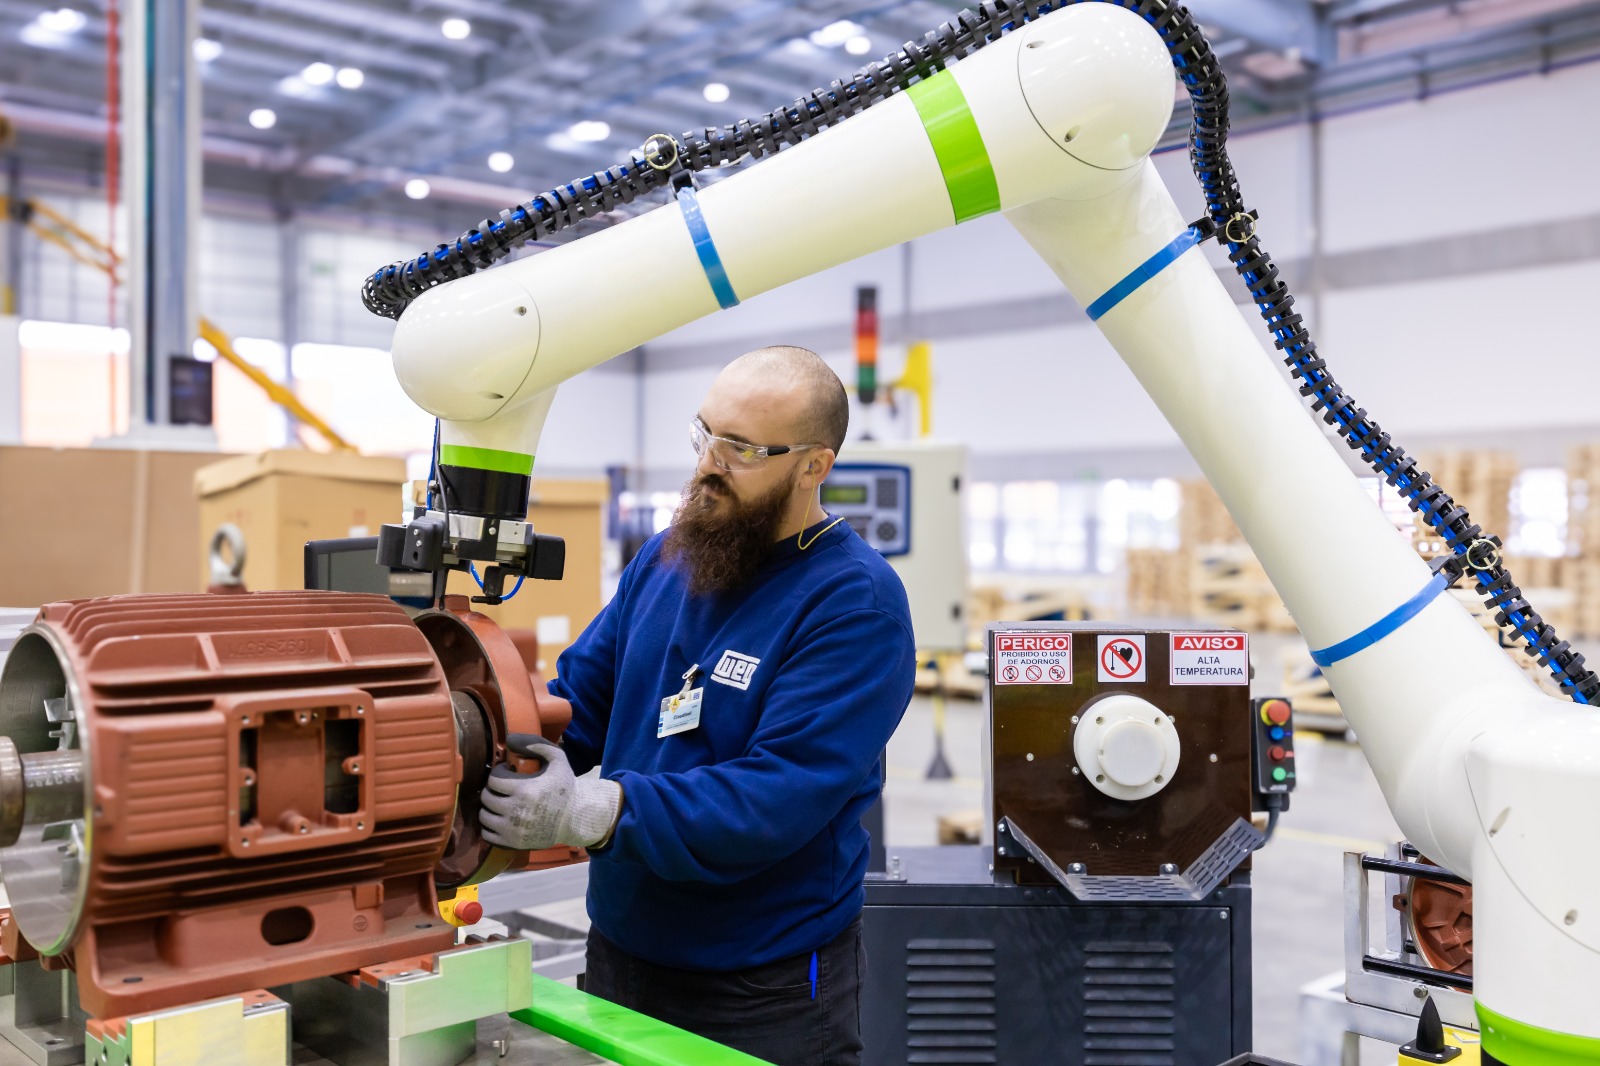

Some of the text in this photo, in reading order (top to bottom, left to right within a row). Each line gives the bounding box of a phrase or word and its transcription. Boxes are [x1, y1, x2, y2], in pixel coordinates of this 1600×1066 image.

[1000, 638, 1067, 649] PERIGO
[1180, 637, 1238, 649] AVISO
[1197, 656, 1220, 664] ALTA
[1175, 667, 1243, 675] TEMPERATURA
